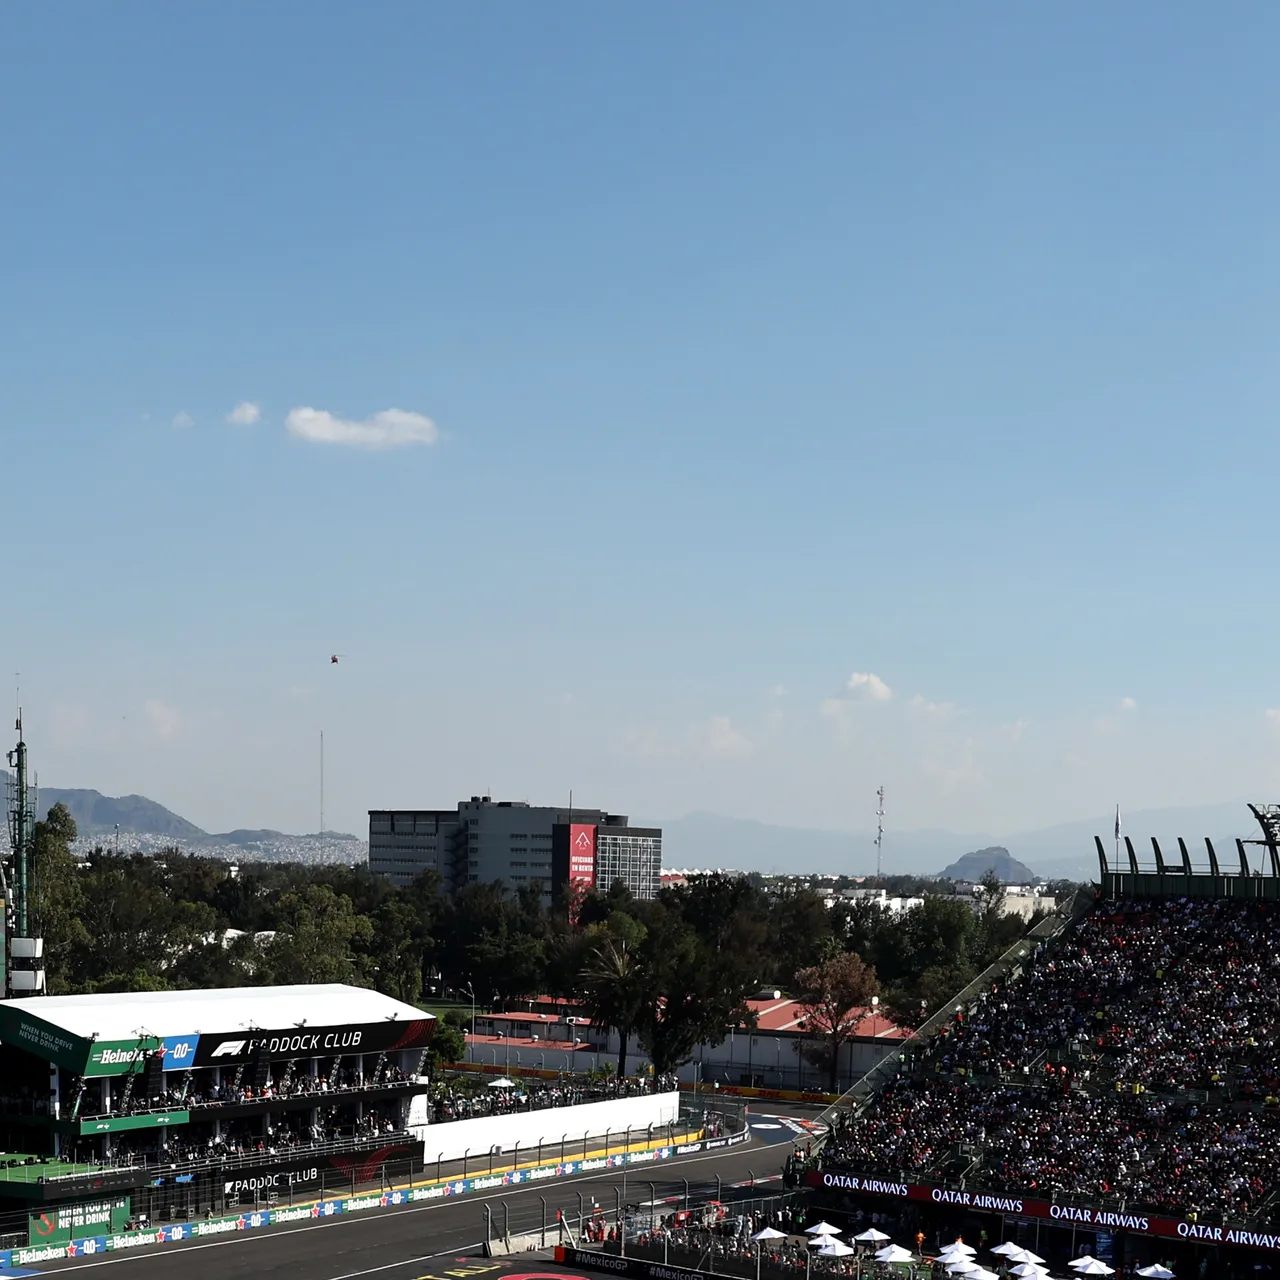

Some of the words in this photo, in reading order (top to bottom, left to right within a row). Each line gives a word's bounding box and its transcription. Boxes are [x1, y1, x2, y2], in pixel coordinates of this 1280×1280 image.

[19, 1030, 40, 1044] NEVER
[40, 1038, 59, 1053] DRINK
[20, 1022, 40, 1036] WHEN
[40, 1030, 54, 1042] YOU
[55, 1037, 74, 1051] DRIVE
[324, 1032, 362, 1048] CLUB
[414, 1186, 444, 1202] Heineken
[823, 1173, 860, 1191] QATAR
[861, 1178, 908, 1196] AIRWAYS
[348, 1194, 380, 1212] Heineken
[932, 1188, 971, 1205] QATAR
[972, 1193, 1023, 1213] AIRWAYS
[58, 1216, 82, 1229] NEVER
[82, 1212, 111, 1225] DRINK
[275, 1207, 310, 1223] Heineken
[1050, 1204, 1092, 1223] QATAR
[1094, 1210, 1148, 1230] AIRWAYS
[198, 1218, 236, 1236] Heineken
[1177, 1222, 1222, 1242] QATAR
[113, 1230, 156, 1250] Heineken
[19, 1242, 65, 1264] Heineken
[575, 1252, 628, 1270] #MexicoGP
[444, 1264, 501, 1278] ALL
